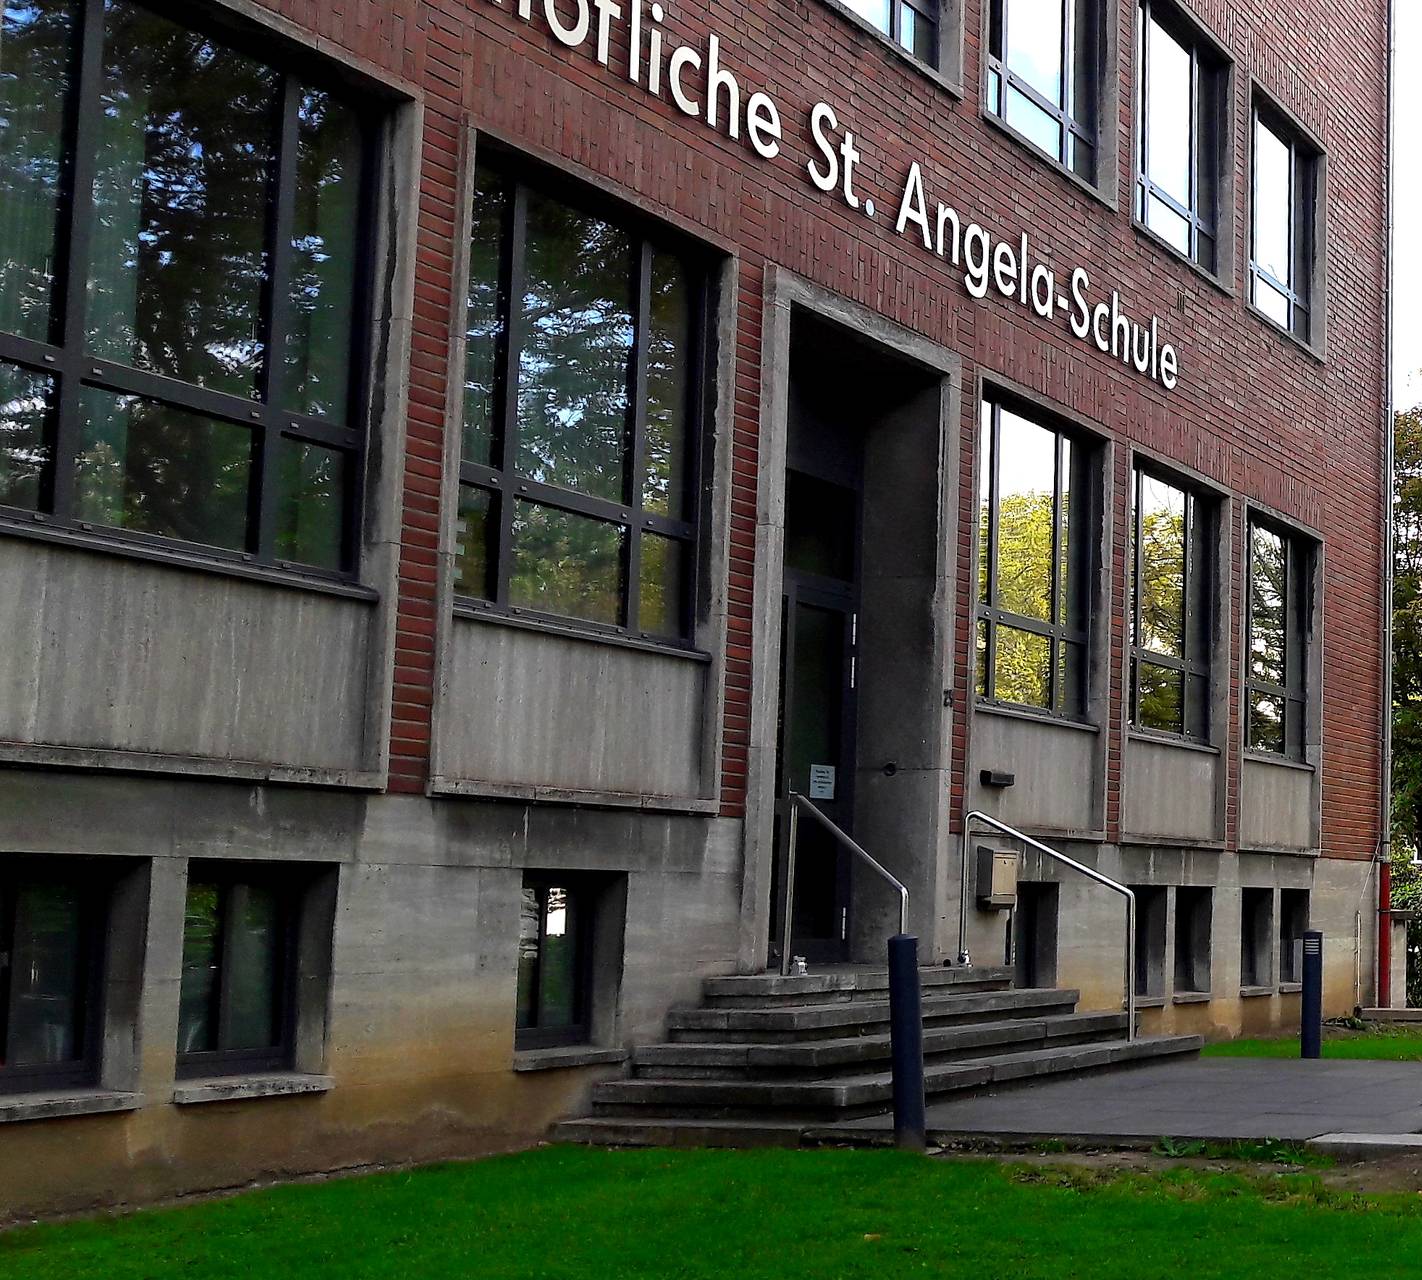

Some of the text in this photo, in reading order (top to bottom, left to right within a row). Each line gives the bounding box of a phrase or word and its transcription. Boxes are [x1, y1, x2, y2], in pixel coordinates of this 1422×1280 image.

[493, 0, 1178, 390] fliche St. Angela-Schule
